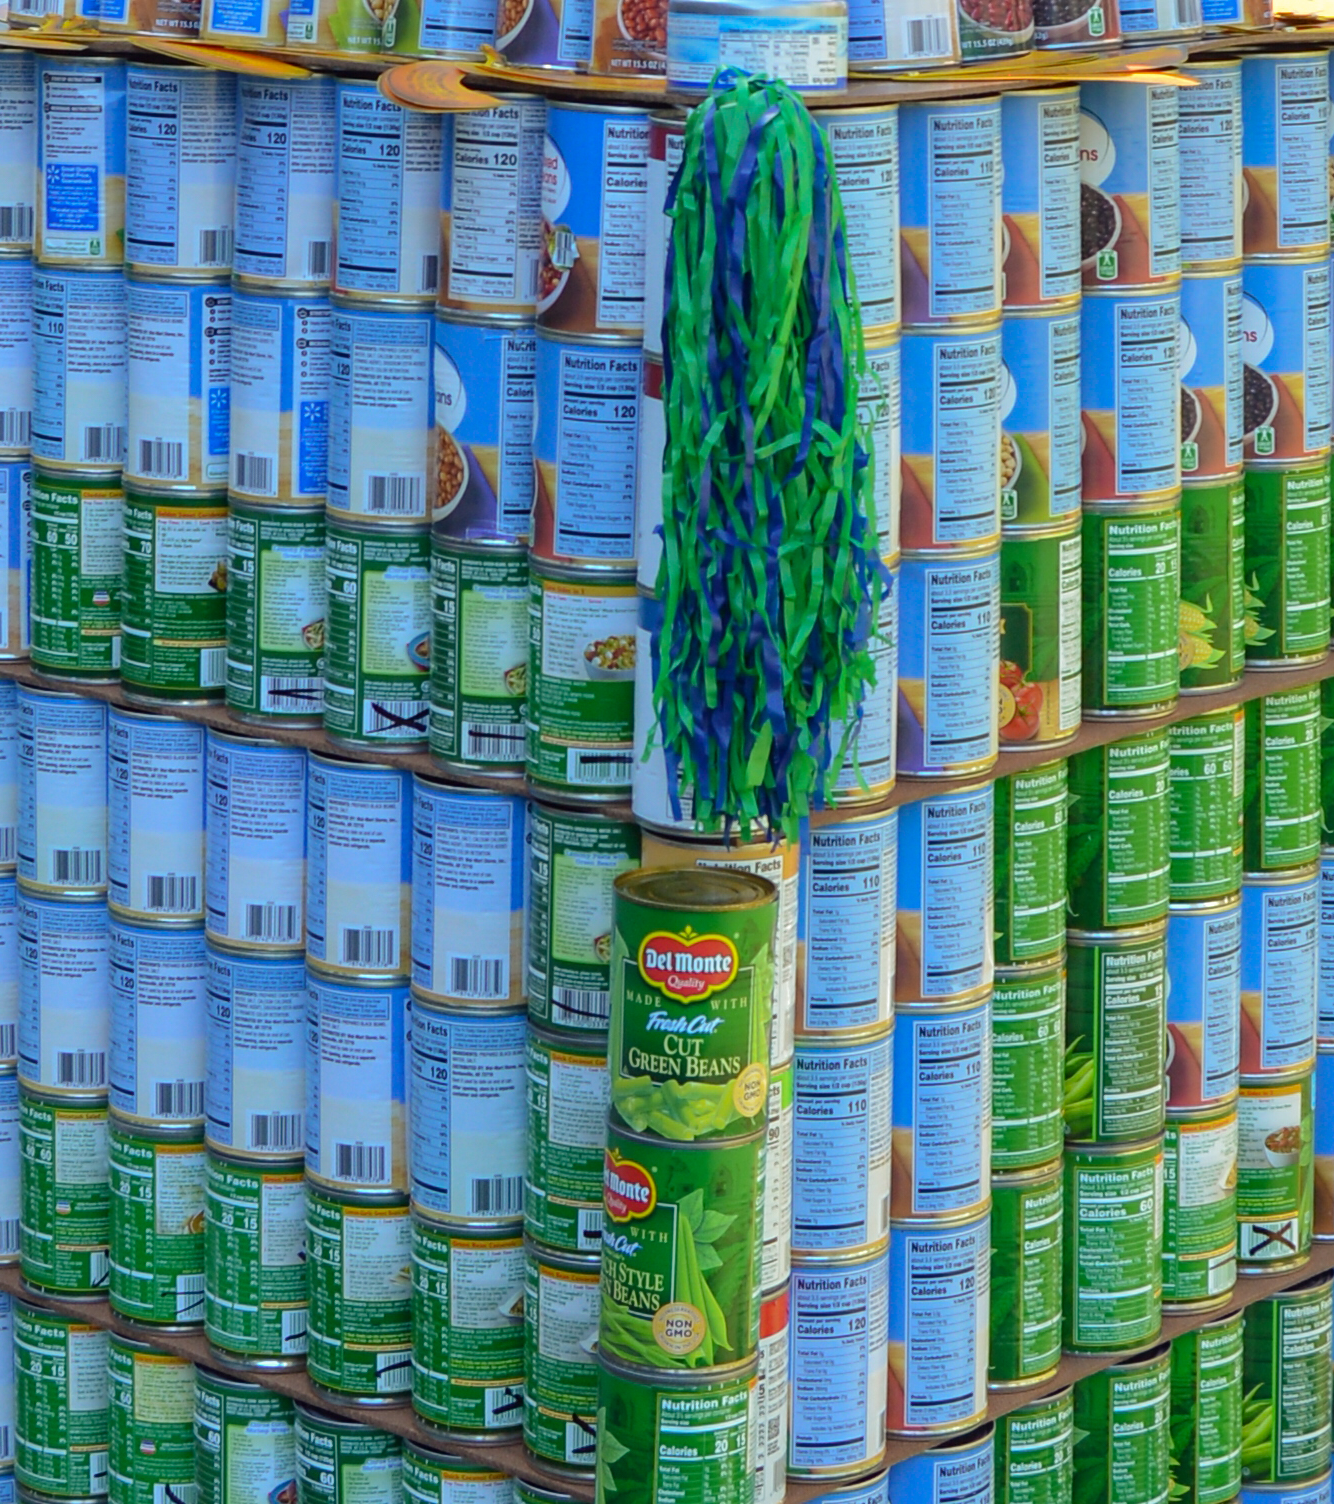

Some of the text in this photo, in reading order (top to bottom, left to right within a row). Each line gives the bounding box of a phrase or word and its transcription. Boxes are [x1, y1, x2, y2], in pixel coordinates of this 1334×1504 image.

[455, 153, 517, 166] Calories 120
[565, 356, 637, 372] Nutrition Facts
[563, 405, 635, 418] Calories 120
[644, 948, 732, 974] Del Monte
[667, 974, 706, 992] Quality
[626, 988, 748, 1011] MADE WITH
[647, 1014, 724, 1035] Fresh Cut
[663, 1034, 704, 1056] CUT
[628, 1053, 741, 1078] GREEN BEANS
[666, 1317, 693, 1329] NON
[665, 1327, 693, 1339] GMO
